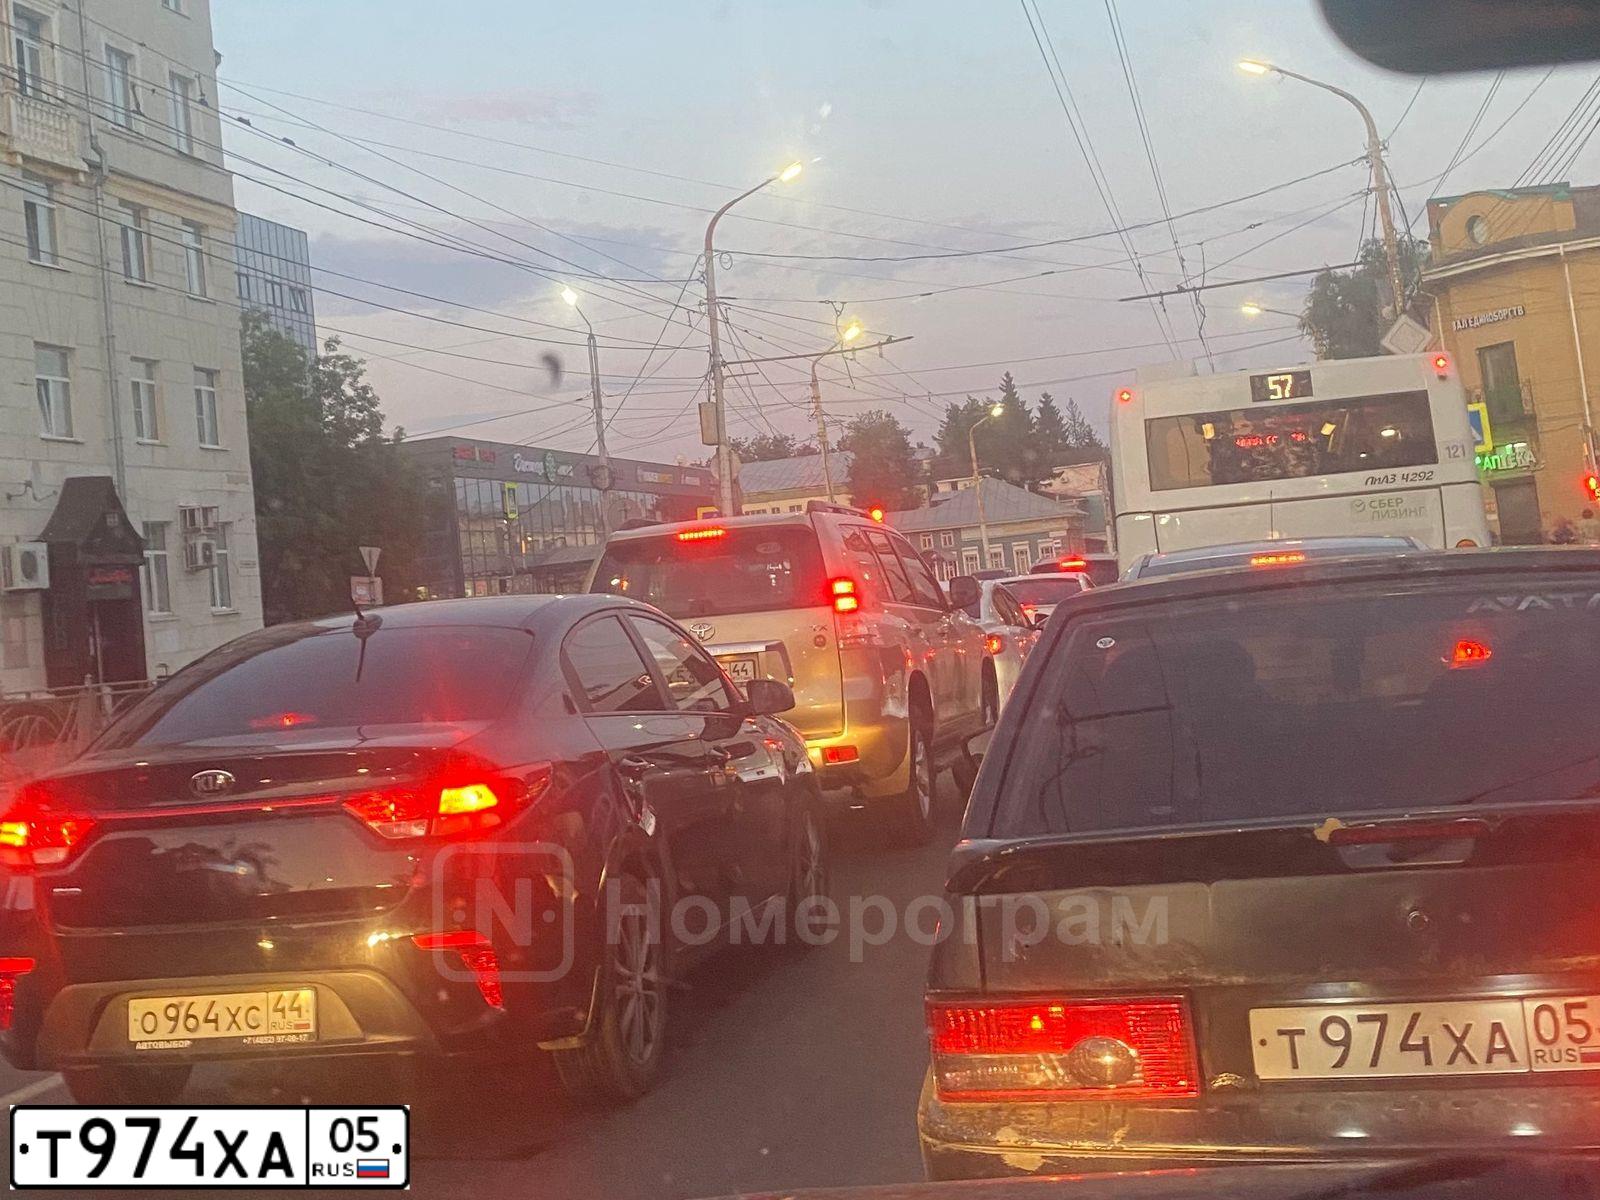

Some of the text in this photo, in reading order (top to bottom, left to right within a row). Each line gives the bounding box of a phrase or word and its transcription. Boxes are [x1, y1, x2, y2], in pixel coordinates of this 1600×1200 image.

[1267, 374, 1293, 400] 57
[1445, 443, 1467, 458] 121
[1483, 447, 1537, 471] АПТЕКА
[1401, 470, 1435, 483] 4292
[1369, 497, 1404, 510] СБЕР
[1371, 506, 1426, 521] ЛИЗИНГ
[732, 662, 748, 677] 44
[272, 992, 302, 1019] 44
[270, 1020, 294, 1031] RUS
[1533, 1001, 1593, 1046] 05
[1277, 1011, 1519, 1070] Т974ХА
[1534, 1046, 1578, 1064] RUS
